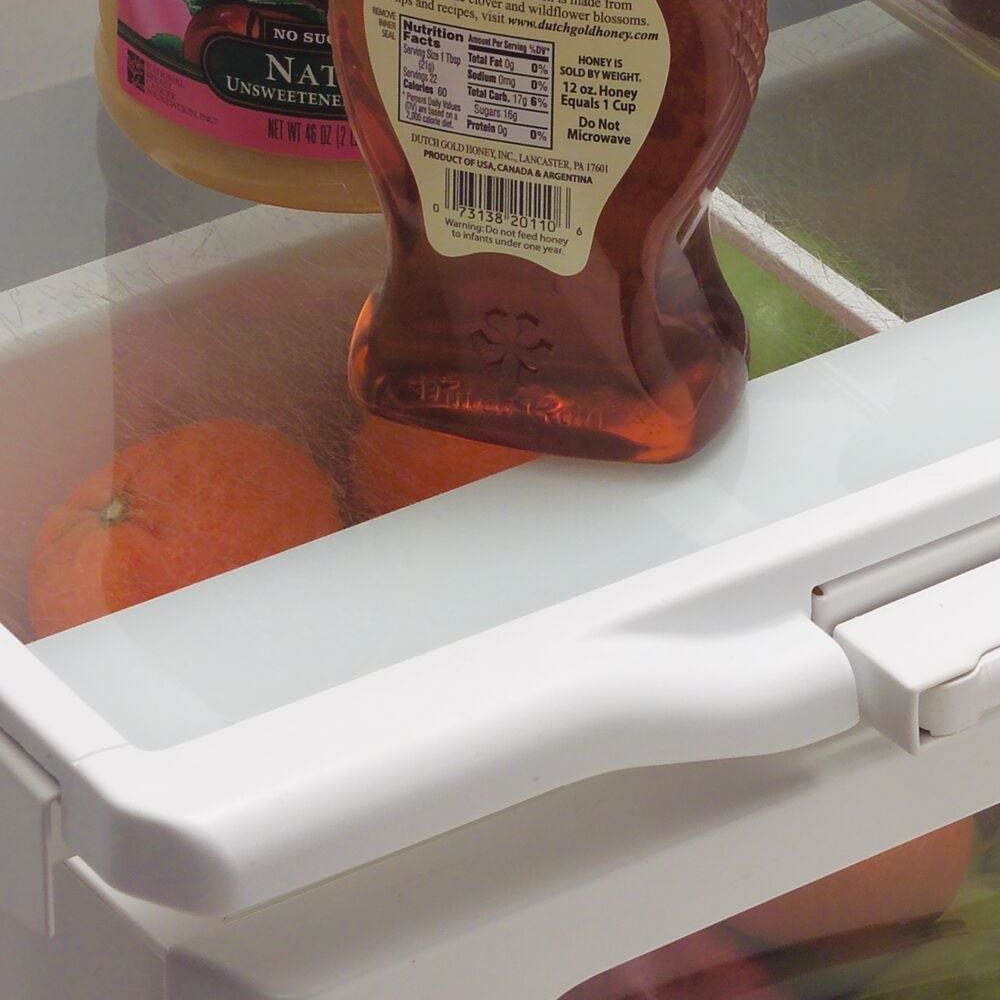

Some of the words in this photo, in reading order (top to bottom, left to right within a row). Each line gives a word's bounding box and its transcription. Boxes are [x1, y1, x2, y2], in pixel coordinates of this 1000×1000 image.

[415, 0, 435, 12] and
[437, 3, 479, 21] recipes,
[481, 11, 505, 24] visit
[508, 16, 660, 42] www.dutchgoldhoney.com
[505, 1, 526, 13] and
[528, 3, 591, 21] wildflower
[593, 10, 650, 27] blossoms.
[273, 27, 298, 42] NO
[402, 20, 464, 43] Nutrition
[403, 31, 441, 49] Facts
[467, 34, 490, 46] Amount
[504, 39, 527, 55] Serving
[265, 53, 338, 88] NAT
[467, 52, 488, 65] Total
[489, 55, 503, 68] Fat
[531, 63, 548, 75] 0%
[578, 55, 612, 68] HONEY
[614, 58, 623, 68] IS
[467, 69, 497, 84] Sodium
[498, 75, 516, 89] 0mg
[530, 80, 548, 92] 0%
[560, 66, 586, 78] SOLD
[587, 68, 601, 80] BY
[602, 70, 642, 83] WEIGHT.
[226, 75, 343, 107] UNSWEETENE
[403, 79, 434, 95] Calories
[467, 86, 488, 98] Total
[489, 89, 511, 103] Carb.
[513, 94, 528, 107] 17g
[530, 96, 548, 109] 6%
[563, 81, 577, 94] 12
[580, 85, 598, 96] oz.
[599, 85, 638, 101] Honey
[474, 103, 501, 120] Sugars
[503, 109, 518, 122] 16g
[560, 94, 600, 110] Equals
[612, 99, 637, 115] Cup
[268, 118, 284, 140] NET
[286, 120, 301, 142] WT
[305, 123, 317, 145] 46
[320, 125, 333, 146] OZ
[466, 119, 496, 134] Protein
[497, 125, 508, 137] 0g
[530, 129, 547, 142] 0%
[579, 116, 596, 129] Do
[598, 118, 620, 132] Not
[567, 128, 632, 145] Microwave
[411, 132, 440, 149] DUTCH
[440, 137, 464, 153] GOLD
[465, 141, 497, 159] HONEY,
[518, 152, 572, 171] LANCASTER,
[573, 159, 585, 172] PA
[586, 161, 609, 174] 17601
[423, 149, 463, 166] PRODUCT
[463, 156, 476, 168] OF
[476, 158, 496, 171] USA,
[497, 163, 534, 178] CANADA
[543, 171, 593, 185] ARGENTINA
[432, 203, 440, 213] 0
[458, 206, 504, 225] 73138
[510, 214, 557, 232] 20110
[575, 226, 584, 237] 6
[444, 216, 485, 234] Warning:
[485, 224, 499, 235] Do
[500, 228, 517, 238] not
[517, 229, 539, 241] feed
[539, 232, 570, 247] honey
[451, 230, 462, 239] to
[462, 231, 494, 246] infants
[494, 235, 522, 249] under
[522, 242, 542, 253] one
[542, 244, 566, 256] year.
